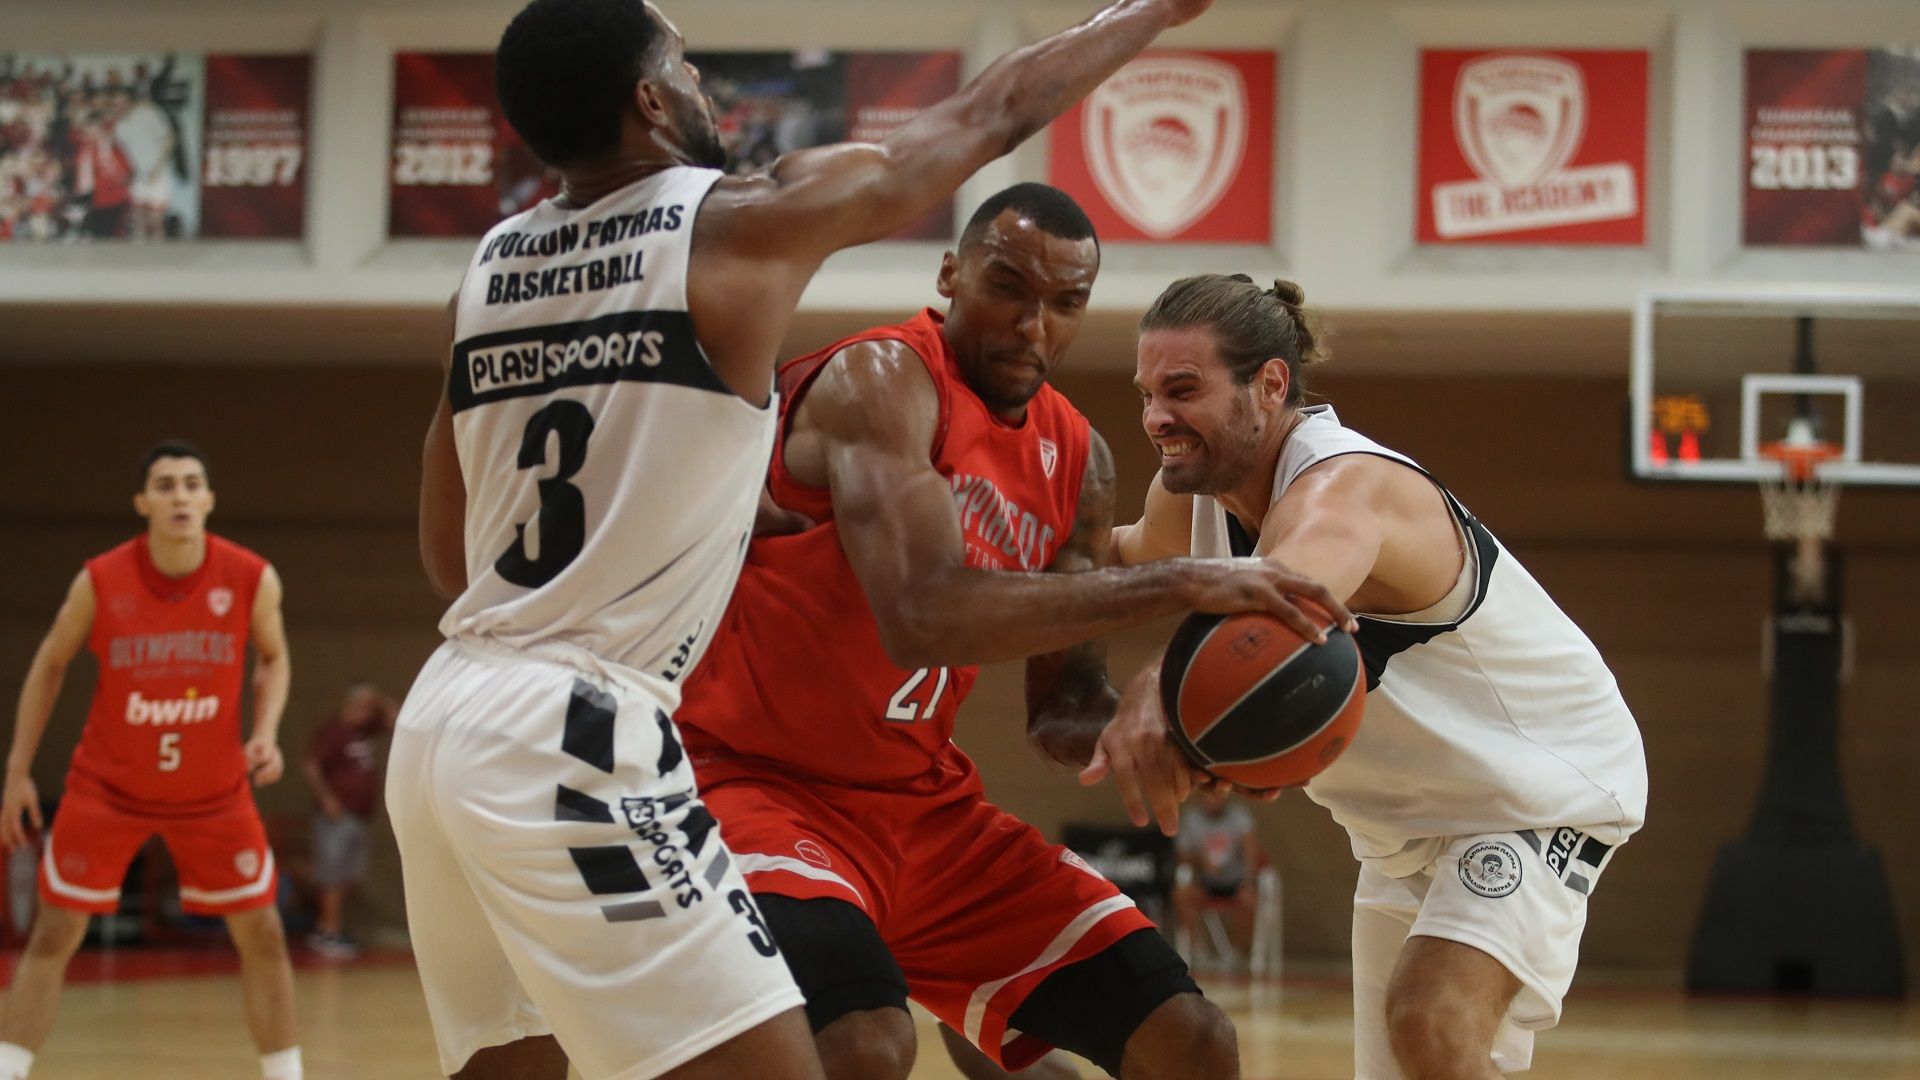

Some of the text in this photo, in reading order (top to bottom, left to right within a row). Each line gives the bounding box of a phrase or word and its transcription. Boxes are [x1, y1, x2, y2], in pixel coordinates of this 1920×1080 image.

[205, 143, 302, 187] 1997
[394, 143, 494, 187] 2012
[1751, 146, 1858, 190] 2013
[479, 204, 684, 267] APOLLON PATRAS
[486, 250, 644, 305] BASKETBALL
[494, 398, 595, 589] 3
[125, 687, 219, 726] bwin
[884, 664, 949, 722] 21
[158, 732, 181, 772] 5
[1548, 828, 1580, 876] PLA
[727, 888, 777, 958] 3
